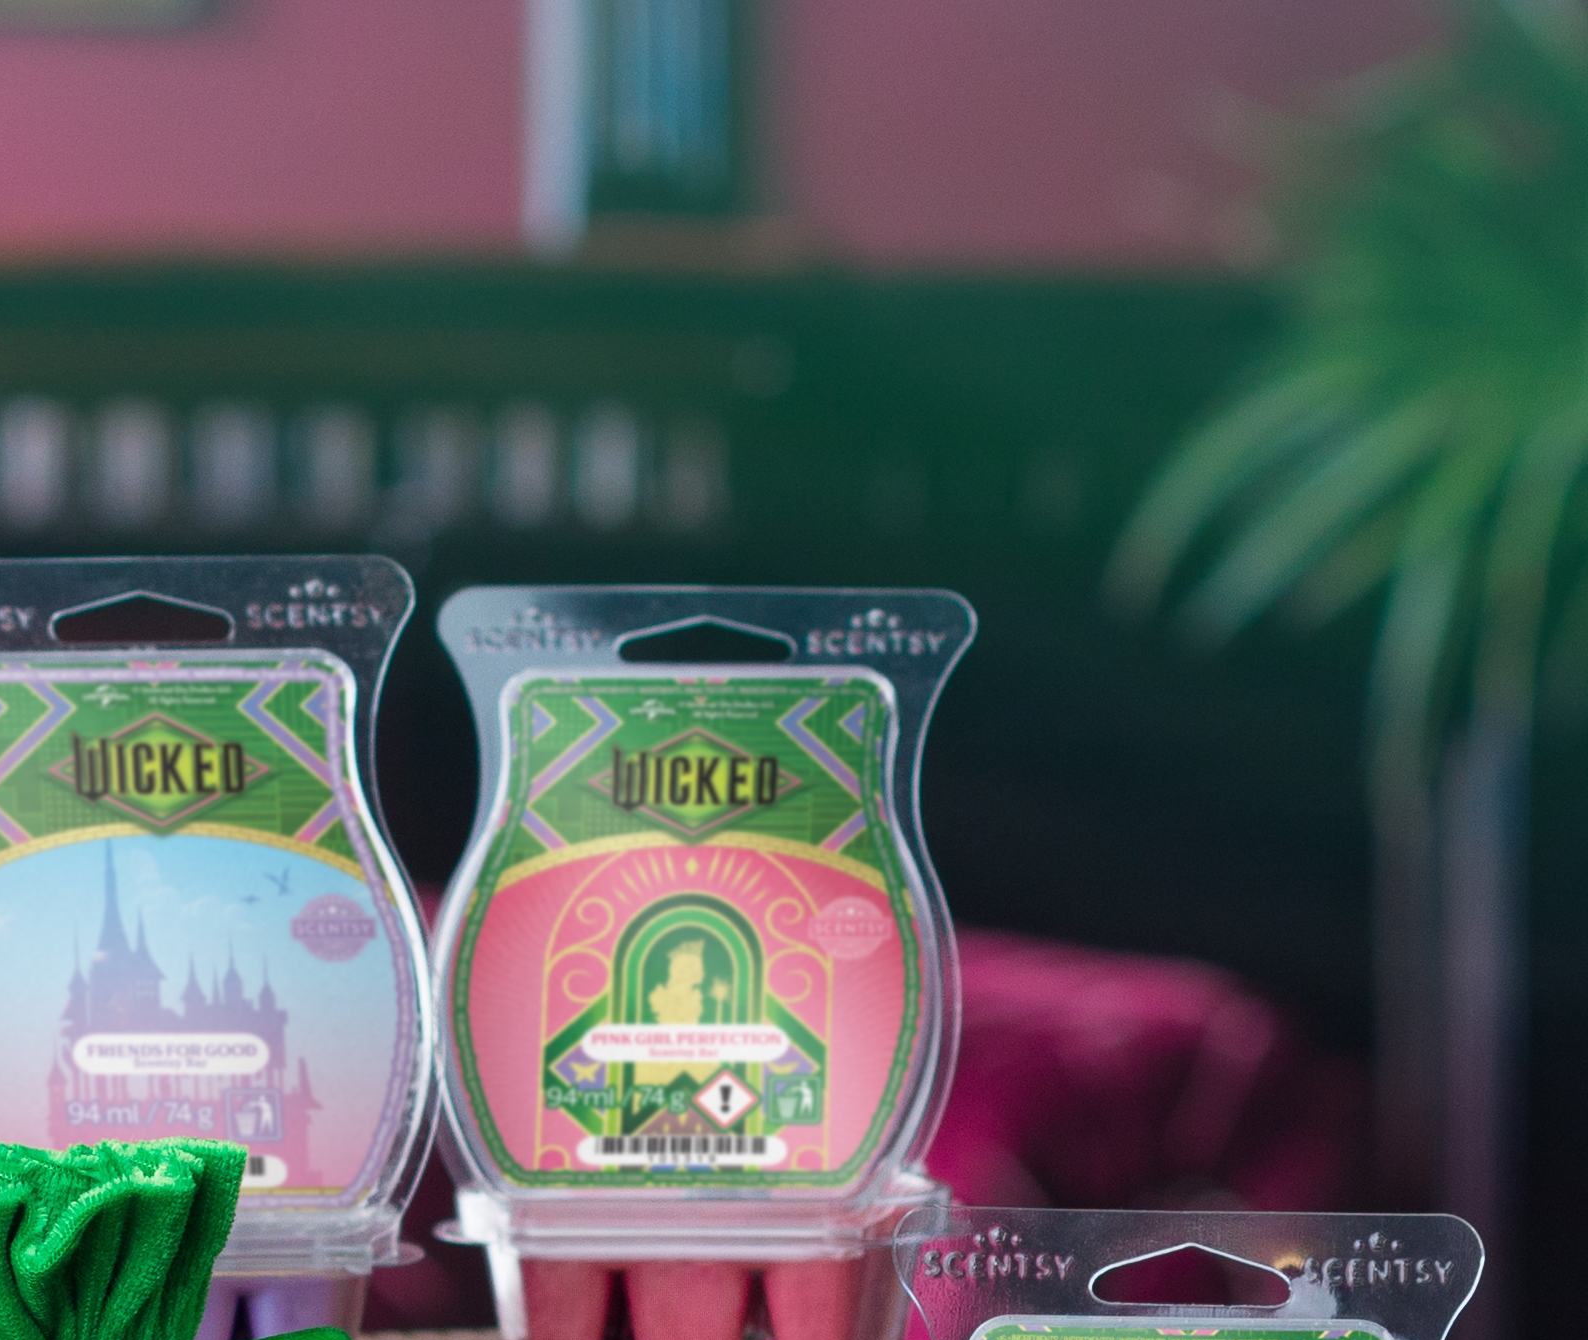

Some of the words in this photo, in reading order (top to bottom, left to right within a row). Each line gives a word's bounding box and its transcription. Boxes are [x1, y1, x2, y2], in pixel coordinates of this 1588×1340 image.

[245, 602, 387, 628] SCENTSY
[806, 629, 946, 655] SCENTSY
[70, 730, 246, 803] WICKED
[611, 743, 779, 812] WICKED
[87, 1043, 164, 1057] FRIENDS
[167, 1043, 197, 1057] FOR
[199, 1043, 258, 1057] GOOD
[591, 1032, 632, 1046] PINK
[634, 1032, 674, 1046] GIRL
[676, 1032, 782, 1046] PERFECTION
[546, 1086, 579, 1109] 94
[583, 1086, 618, 1108] ml
[640, 1087, 666, 1108] 74
[670, 1091, 687, 1113] g
[67, 1101, 101, 1125] 94
[105, 1100, 140, 1124] ml
[164, 1101, 193, 1123] 74
[196, 1105, 214, 1130] g
[922, 1250, 1075, 1280] SCENTSY
[1303, 1256, 1454, 1286] SCENTSY
